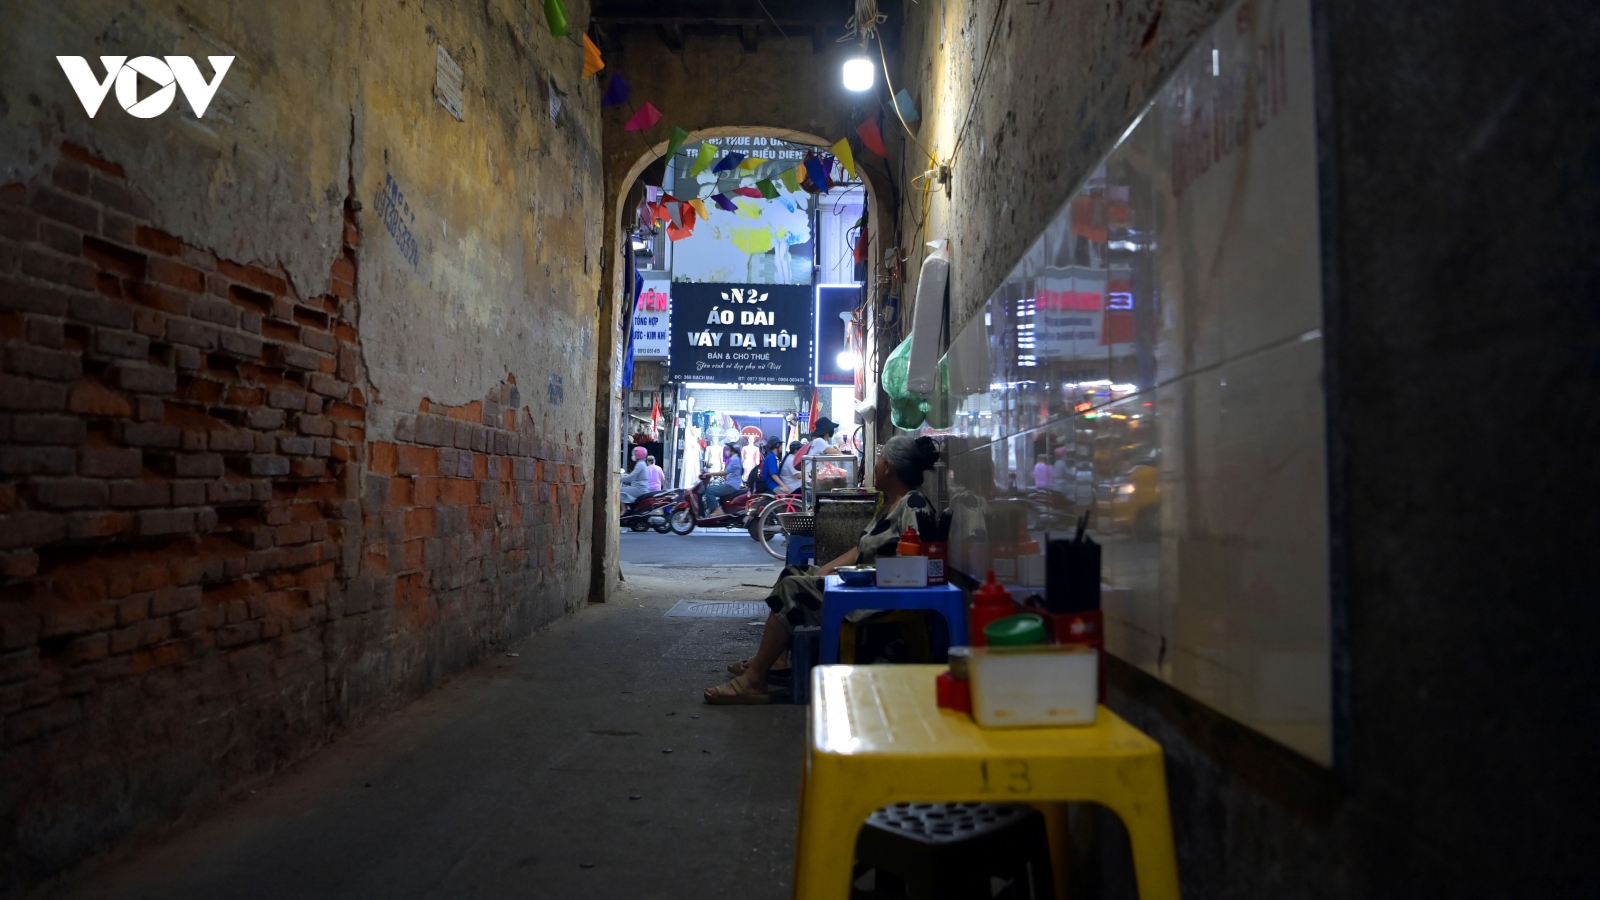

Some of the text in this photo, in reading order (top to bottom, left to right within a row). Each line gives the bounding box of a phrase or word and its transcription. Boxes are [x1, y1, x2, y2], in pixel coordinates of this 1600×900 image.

[706, 306, 775, 326] ÁO DÀI
[687, 329, 798, 351] VÁY DẠ HỘI
[707, 351, 723, 360] BÁN
[751, 353, 770, 361] THUÊ
[979, 759, 1034, 793] 13
